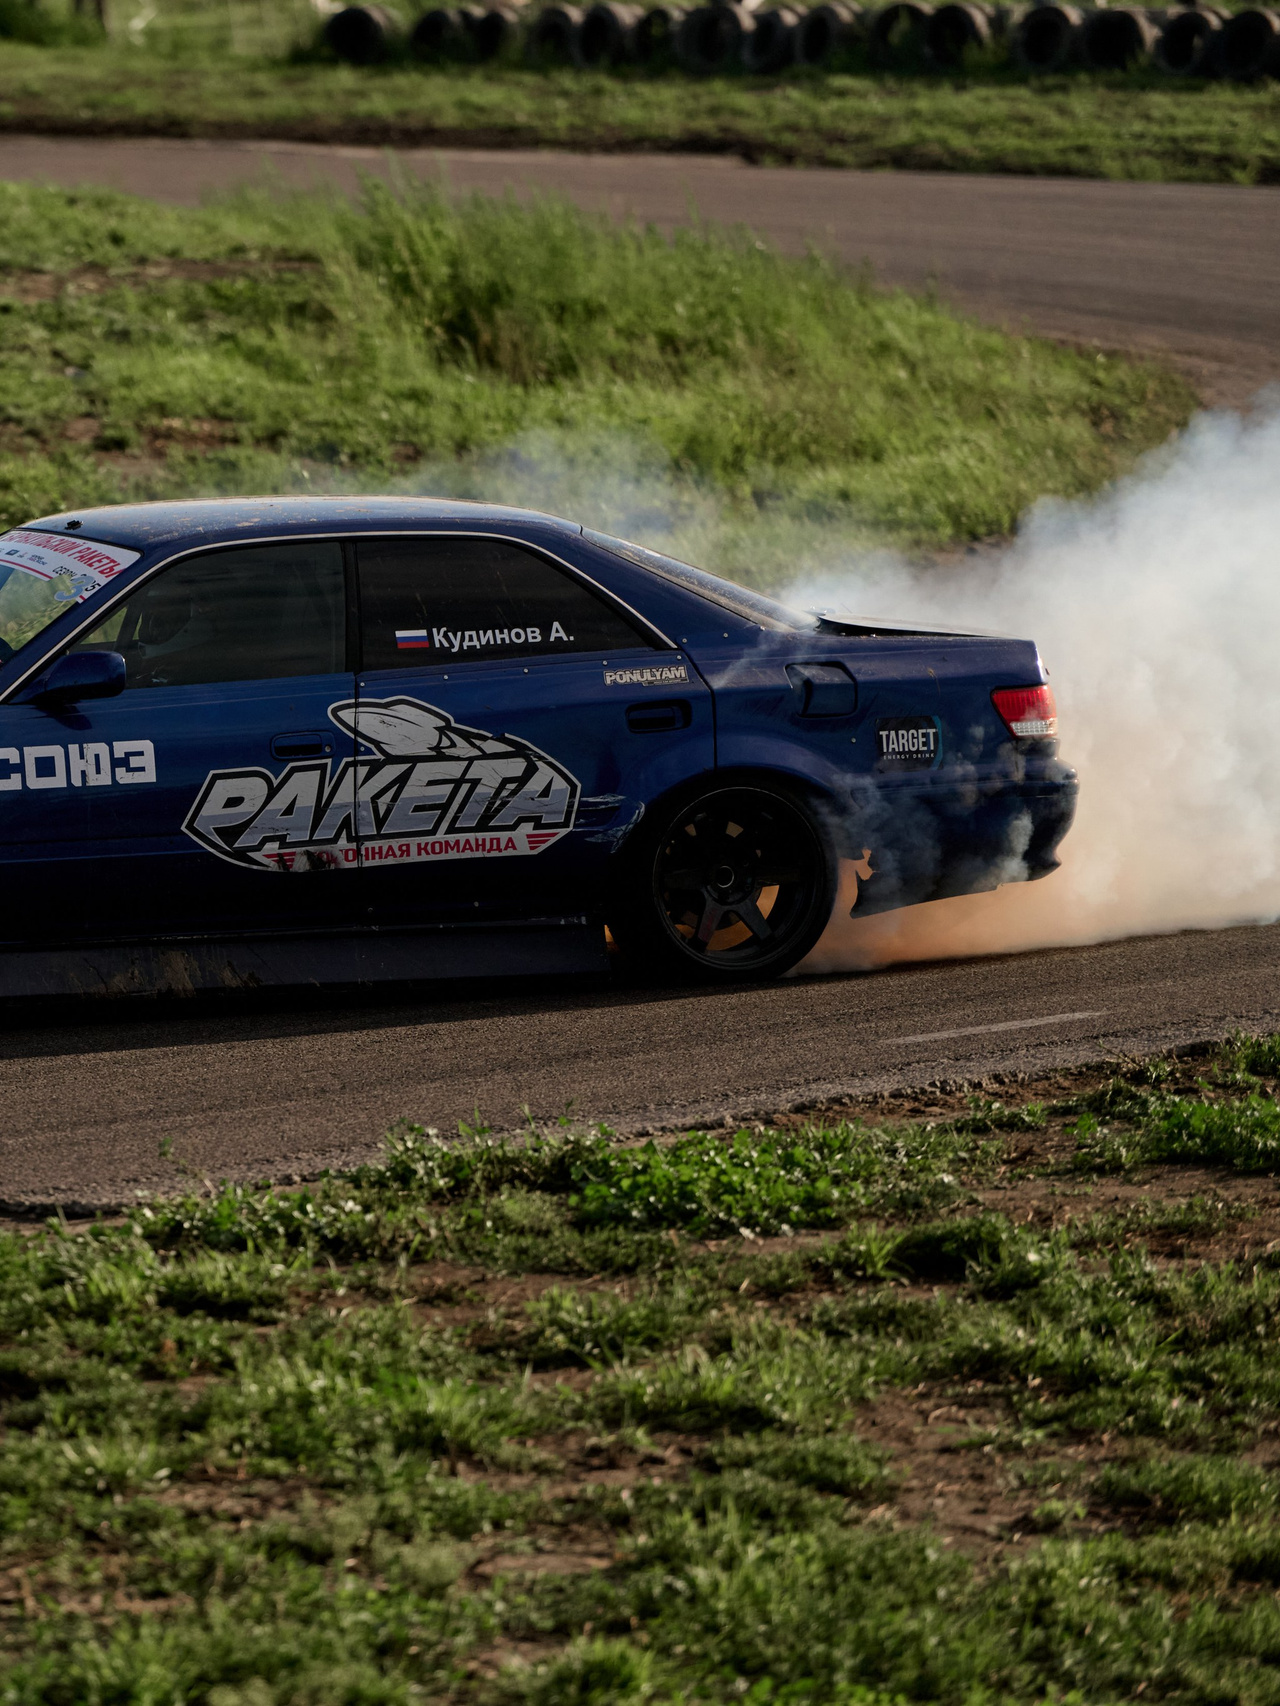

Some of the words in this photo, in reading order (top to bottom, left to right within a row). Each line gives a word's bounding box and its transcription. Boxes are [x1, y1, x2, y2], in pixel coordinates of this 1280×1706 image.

[68, 545, 127, 579] РАКЕТЫ
[432, 626, 542, 652] Кудинов
[549, 621, 575, 642] А.
[605, 666, 687, 685] PONULYAM
[879, 728, 937, 753] TARGET
[192, 758, 572, 850] РАКЕТА
[416, 837, 518, 857] КОМАНДА
